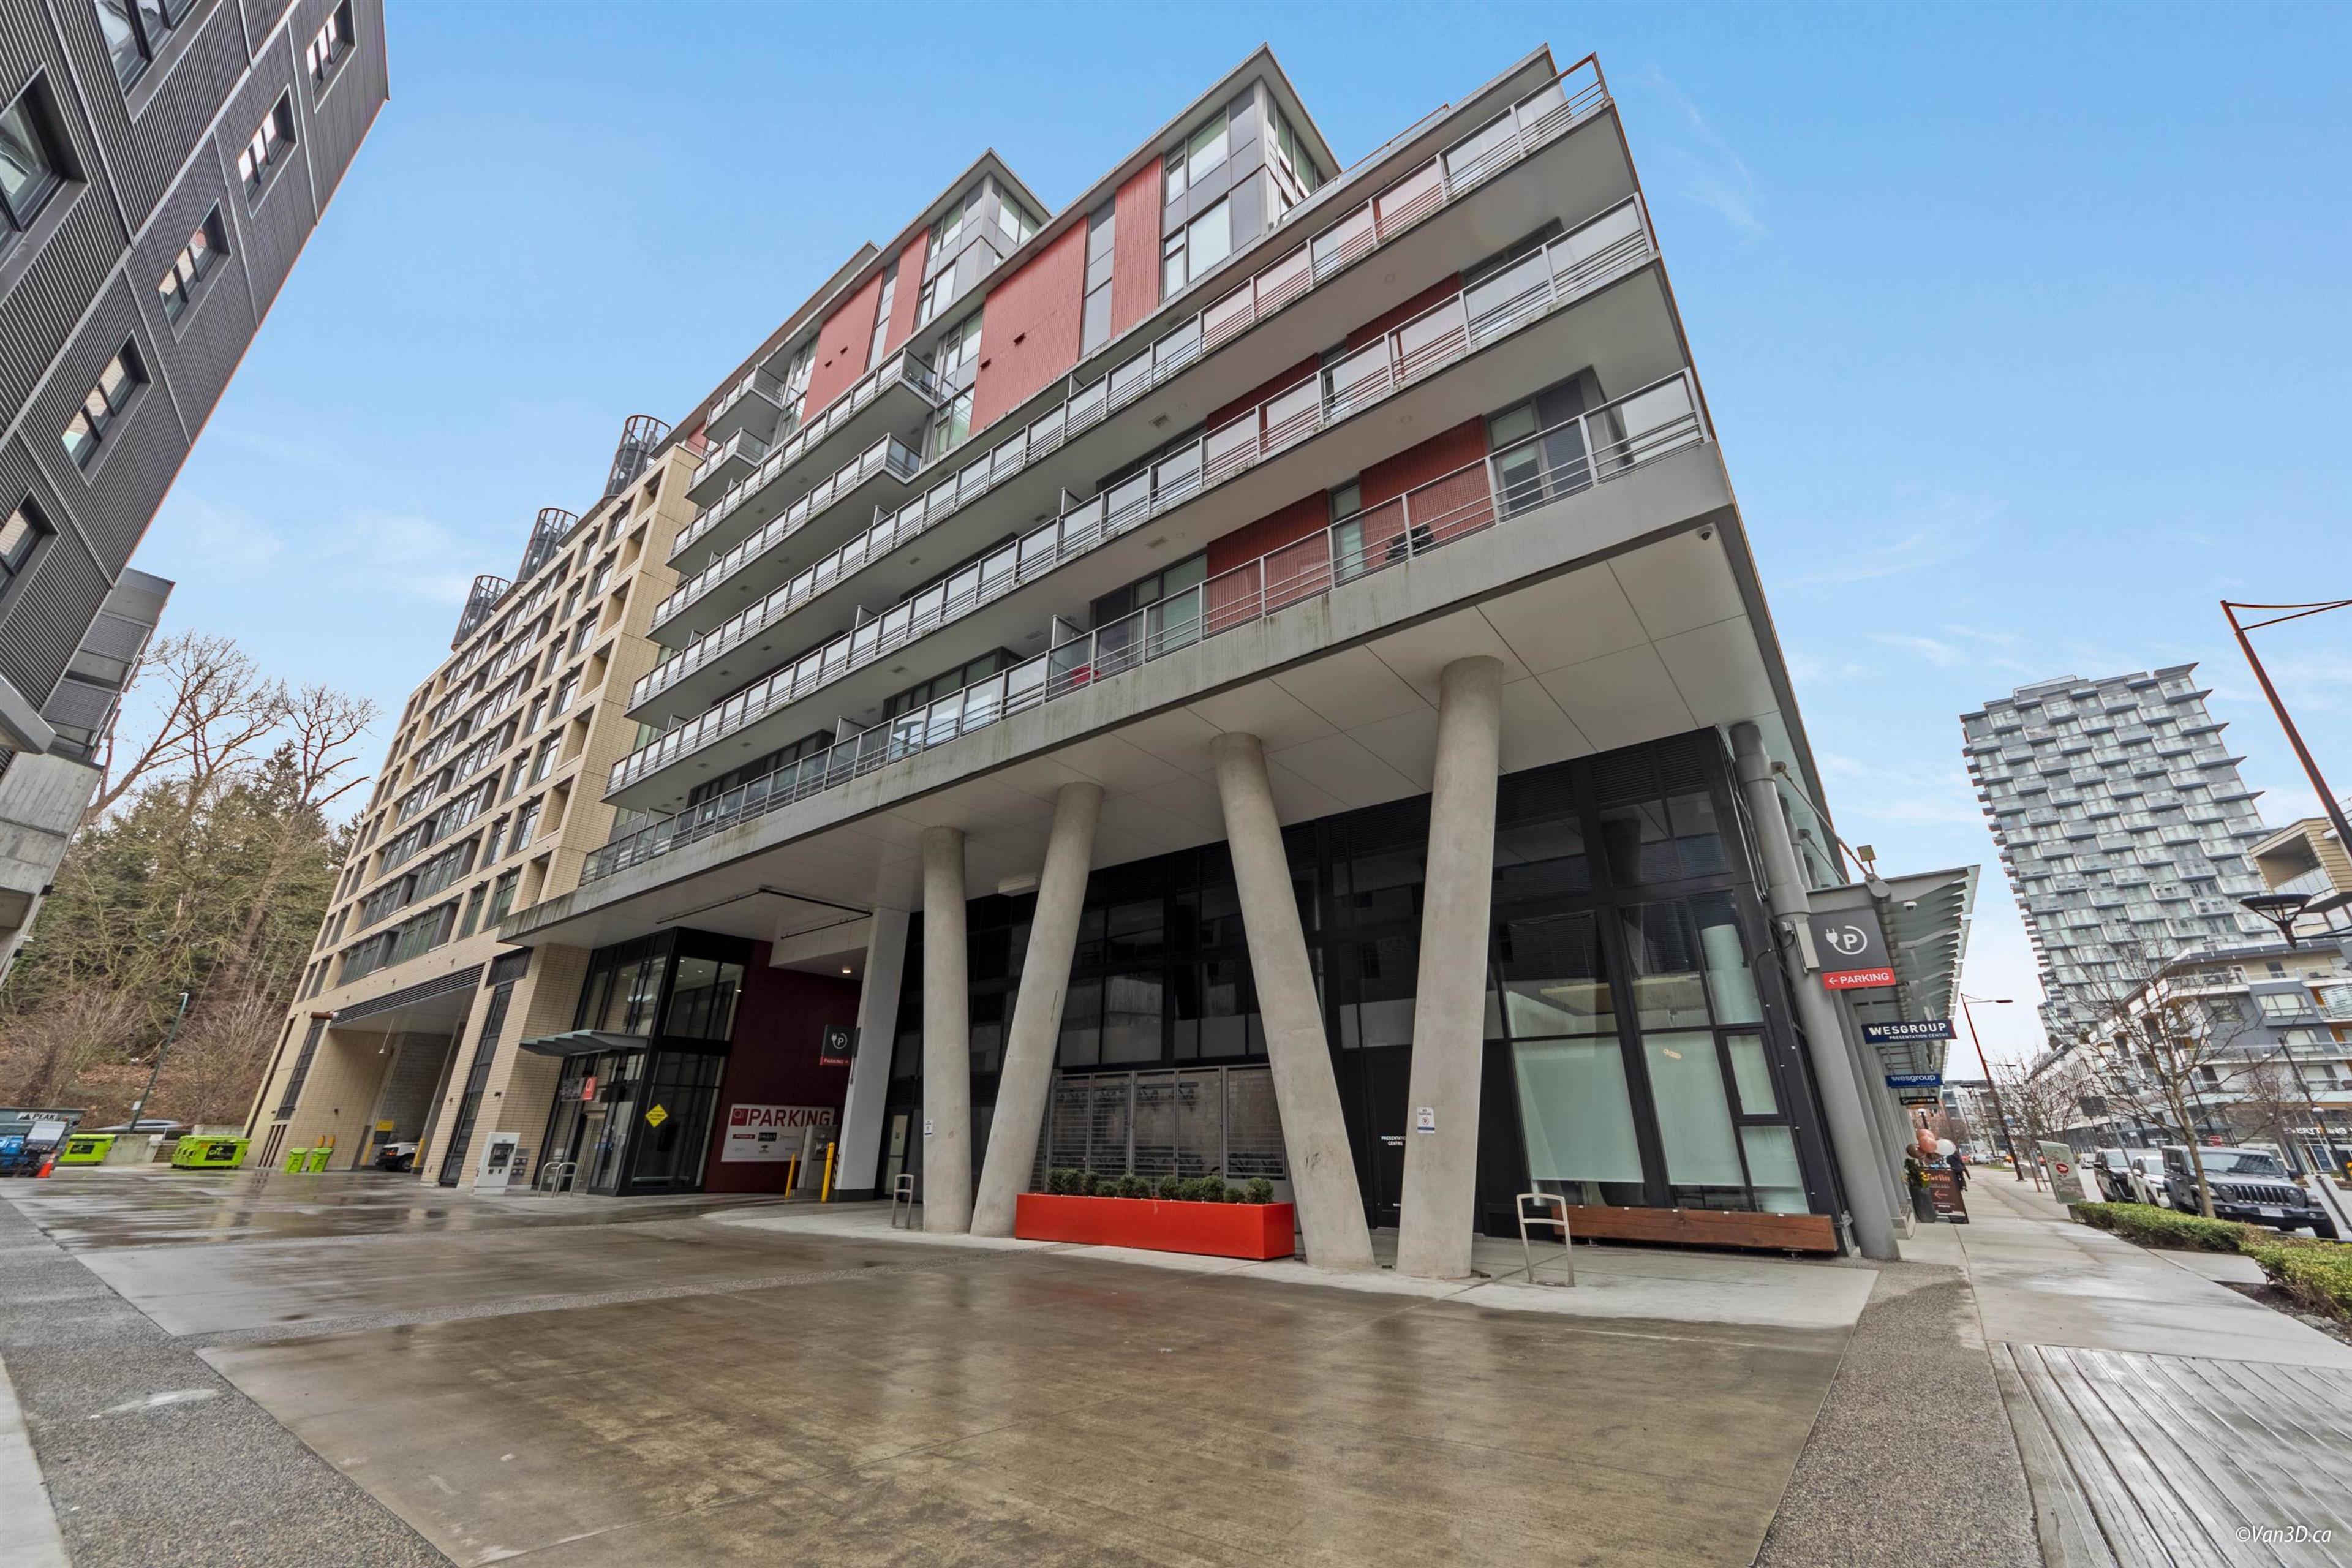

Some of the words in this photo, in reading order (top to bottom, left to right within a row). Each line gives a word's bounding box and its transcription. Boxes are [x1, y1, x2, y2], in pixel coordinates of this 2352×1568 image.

[1842, 933, 1858, 949] P
[1839, 973, 1890, 984] PARKING
[1868, 1022, 1947, 1035] WESGROUP
[1891, 1074, 1936, 1083] wesgroup
[748, 1109, 831, 1127] PARKING
